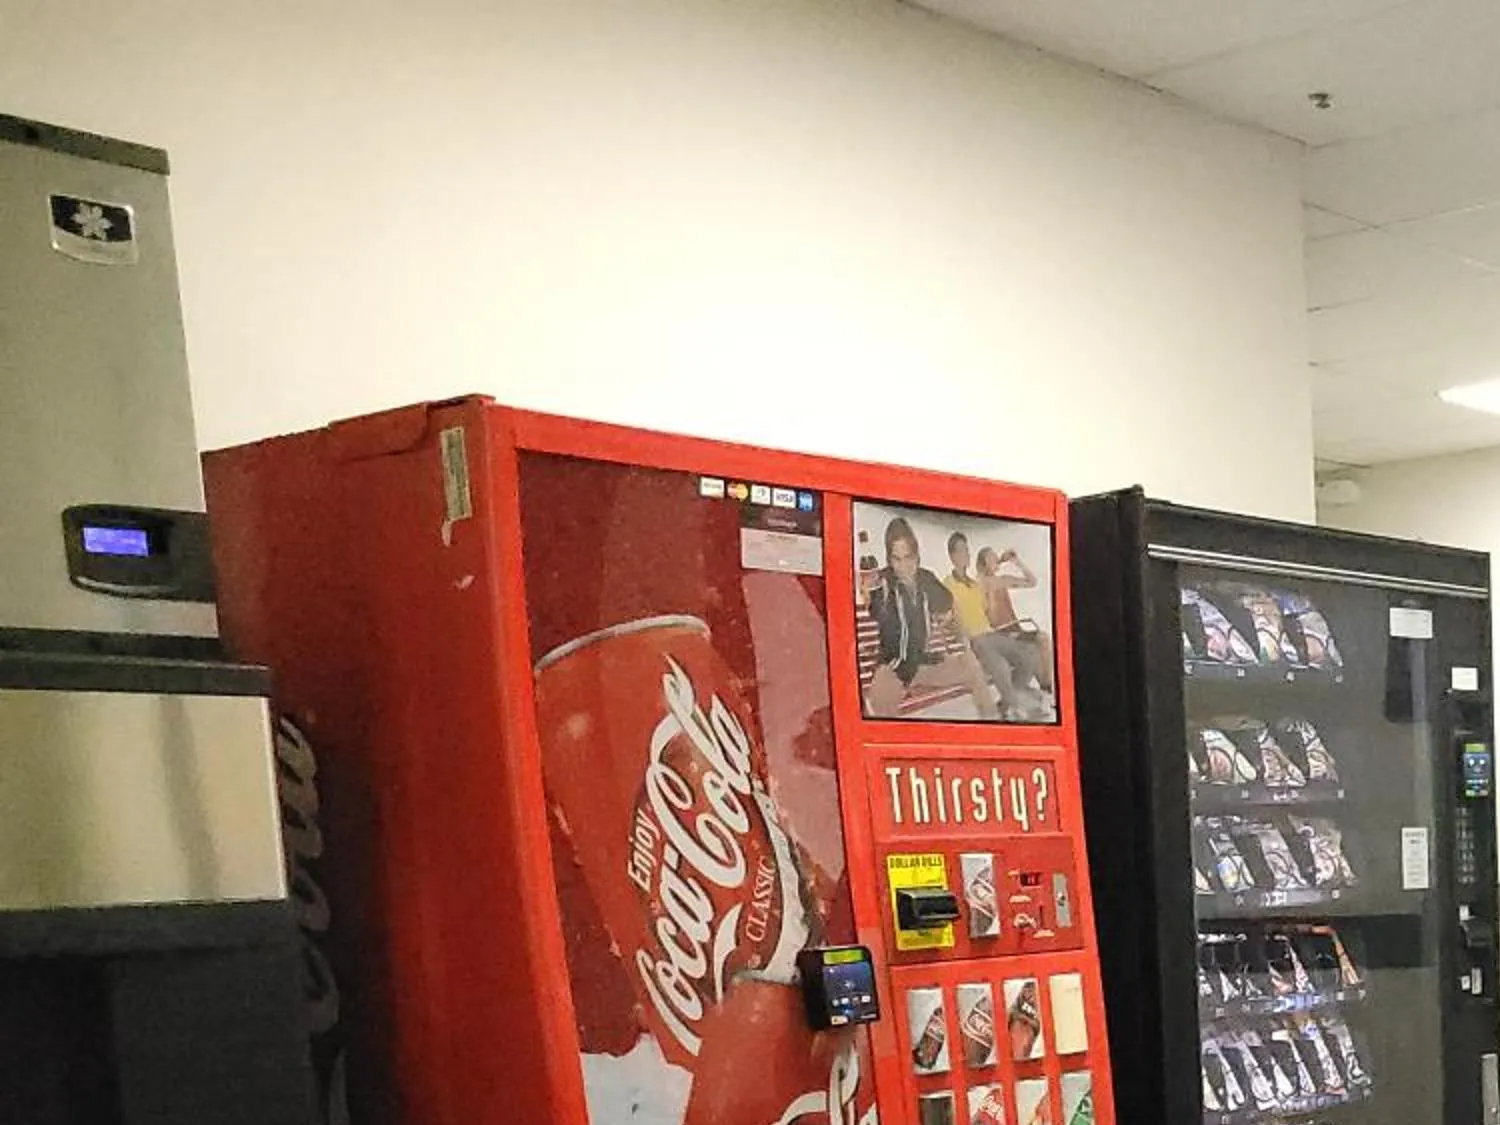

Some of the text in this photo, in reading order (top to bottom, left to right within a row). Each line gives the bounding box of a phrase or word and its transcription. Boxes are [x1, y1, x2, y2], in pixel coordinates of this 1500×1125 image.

[885, 766, 1048, 832] Thirsty?
[627, 807, 662, 894] Enjoy
[636, 652, 754, 1057] Coca-Cola
[745, 855, 778, 943] CLASSIC
